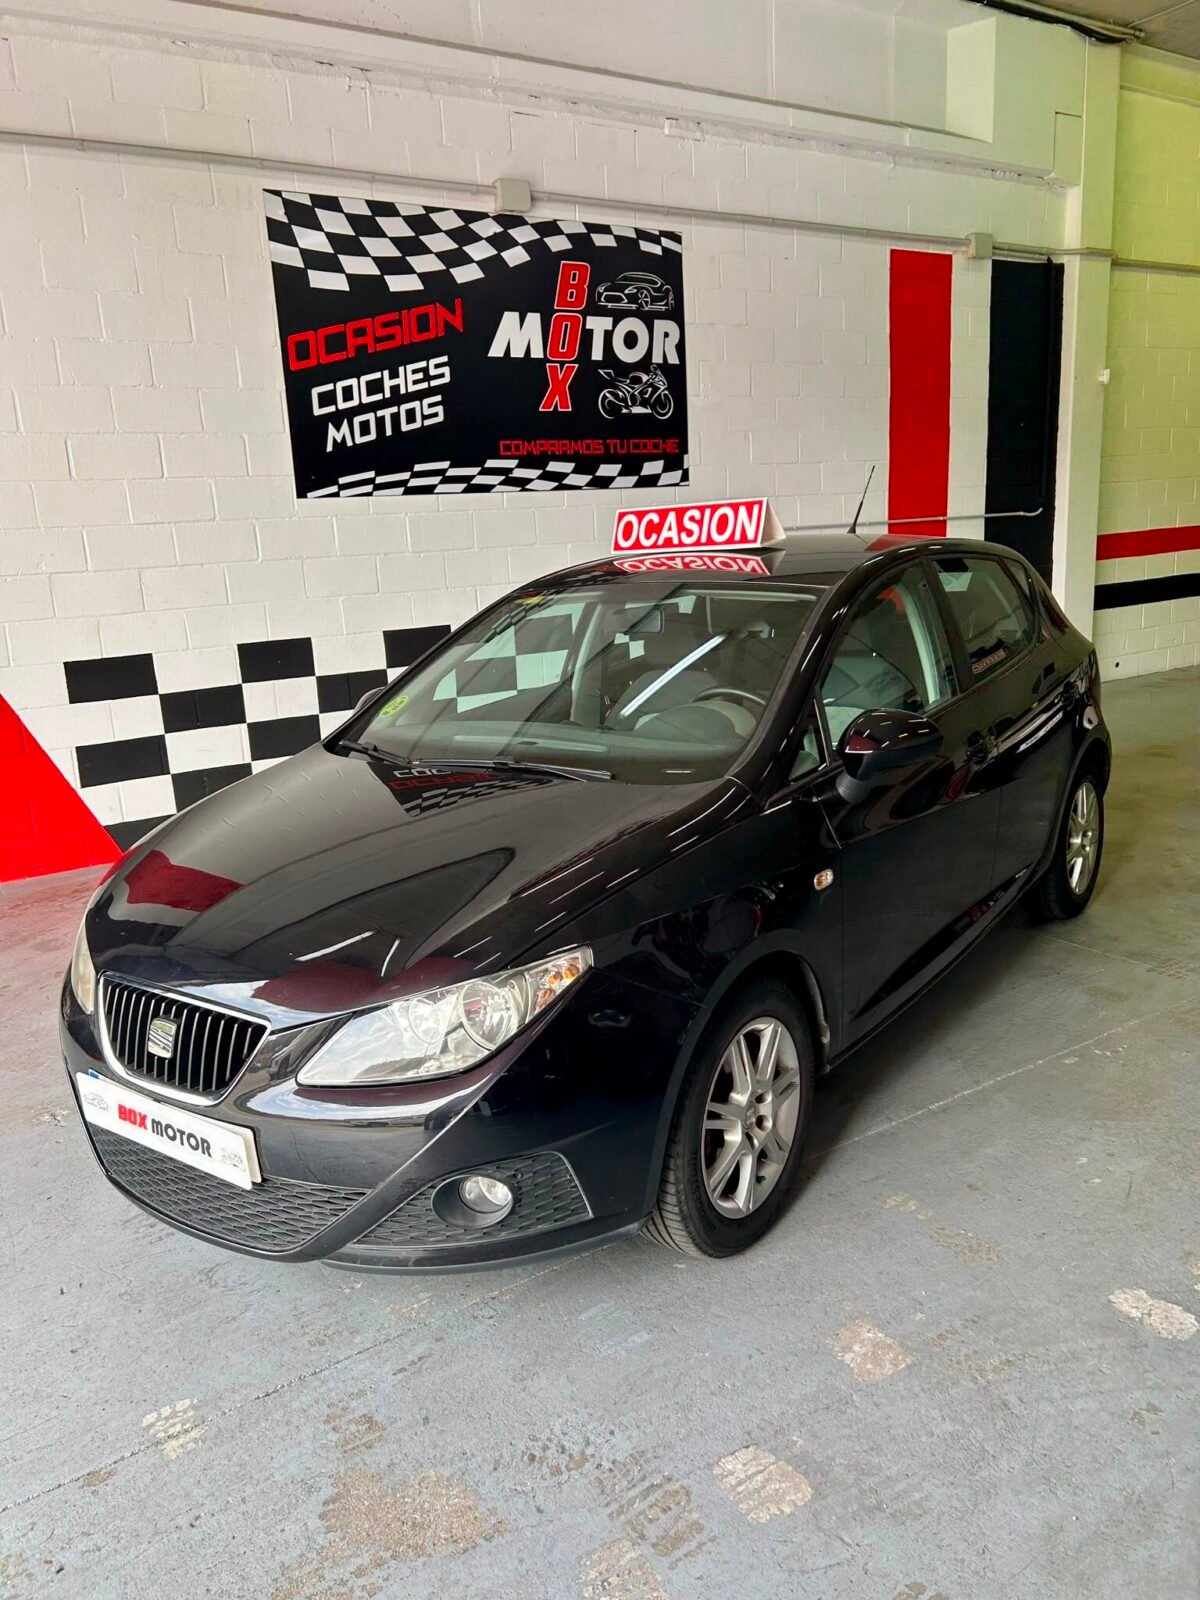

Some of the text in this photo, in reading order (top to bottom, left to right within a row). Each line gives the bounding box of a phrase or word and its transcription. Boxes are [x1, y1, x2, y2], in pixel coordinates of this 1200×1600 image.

[287, 298, 464, 372] OCASION
[487, 311, 681, 365] MOTOR
[539, 260, 591, 412] BOX
[311, 355, 451, 416] COCHES
[326, 395, 444, 453] MOTOS
[499, 438, 680, 456] COMPRAMOS TU COCHE
[616, 503, 760, 549] OCASION
[117, 1103, 213, 1158] BOX MOTOR
